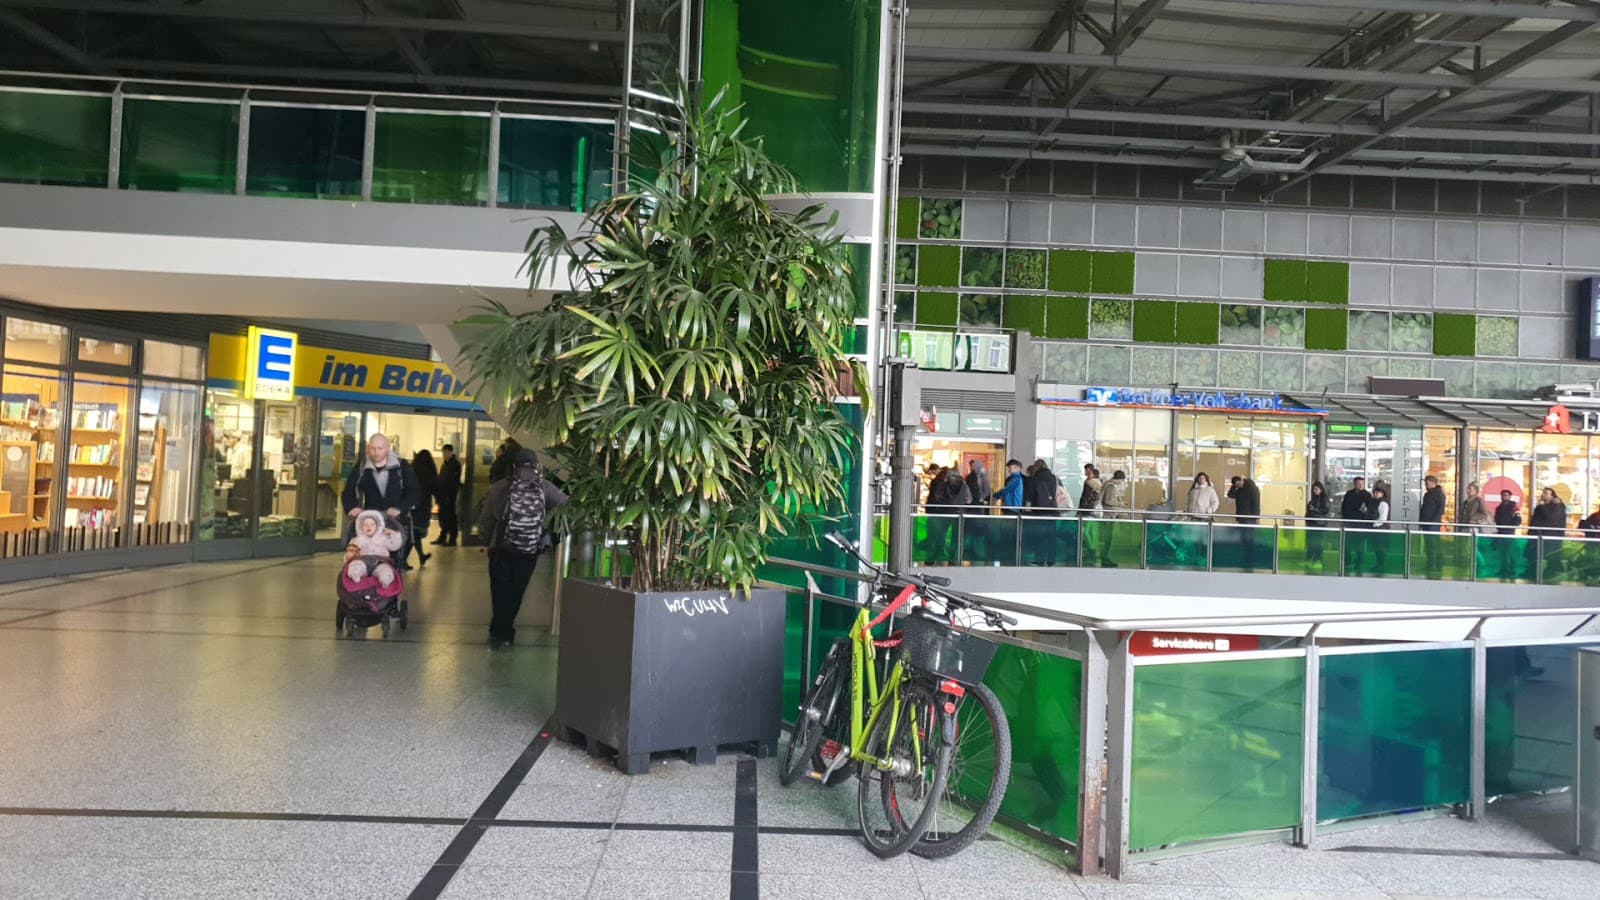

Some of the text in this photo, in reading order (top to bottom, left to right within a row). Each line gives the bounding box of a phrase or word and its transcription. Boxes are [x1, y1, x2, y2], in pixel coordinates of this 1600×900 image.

[257, 334, 292, 381] E
[319, 356, 367, 387] im
[255, 383, 291, 394] EDEKA
